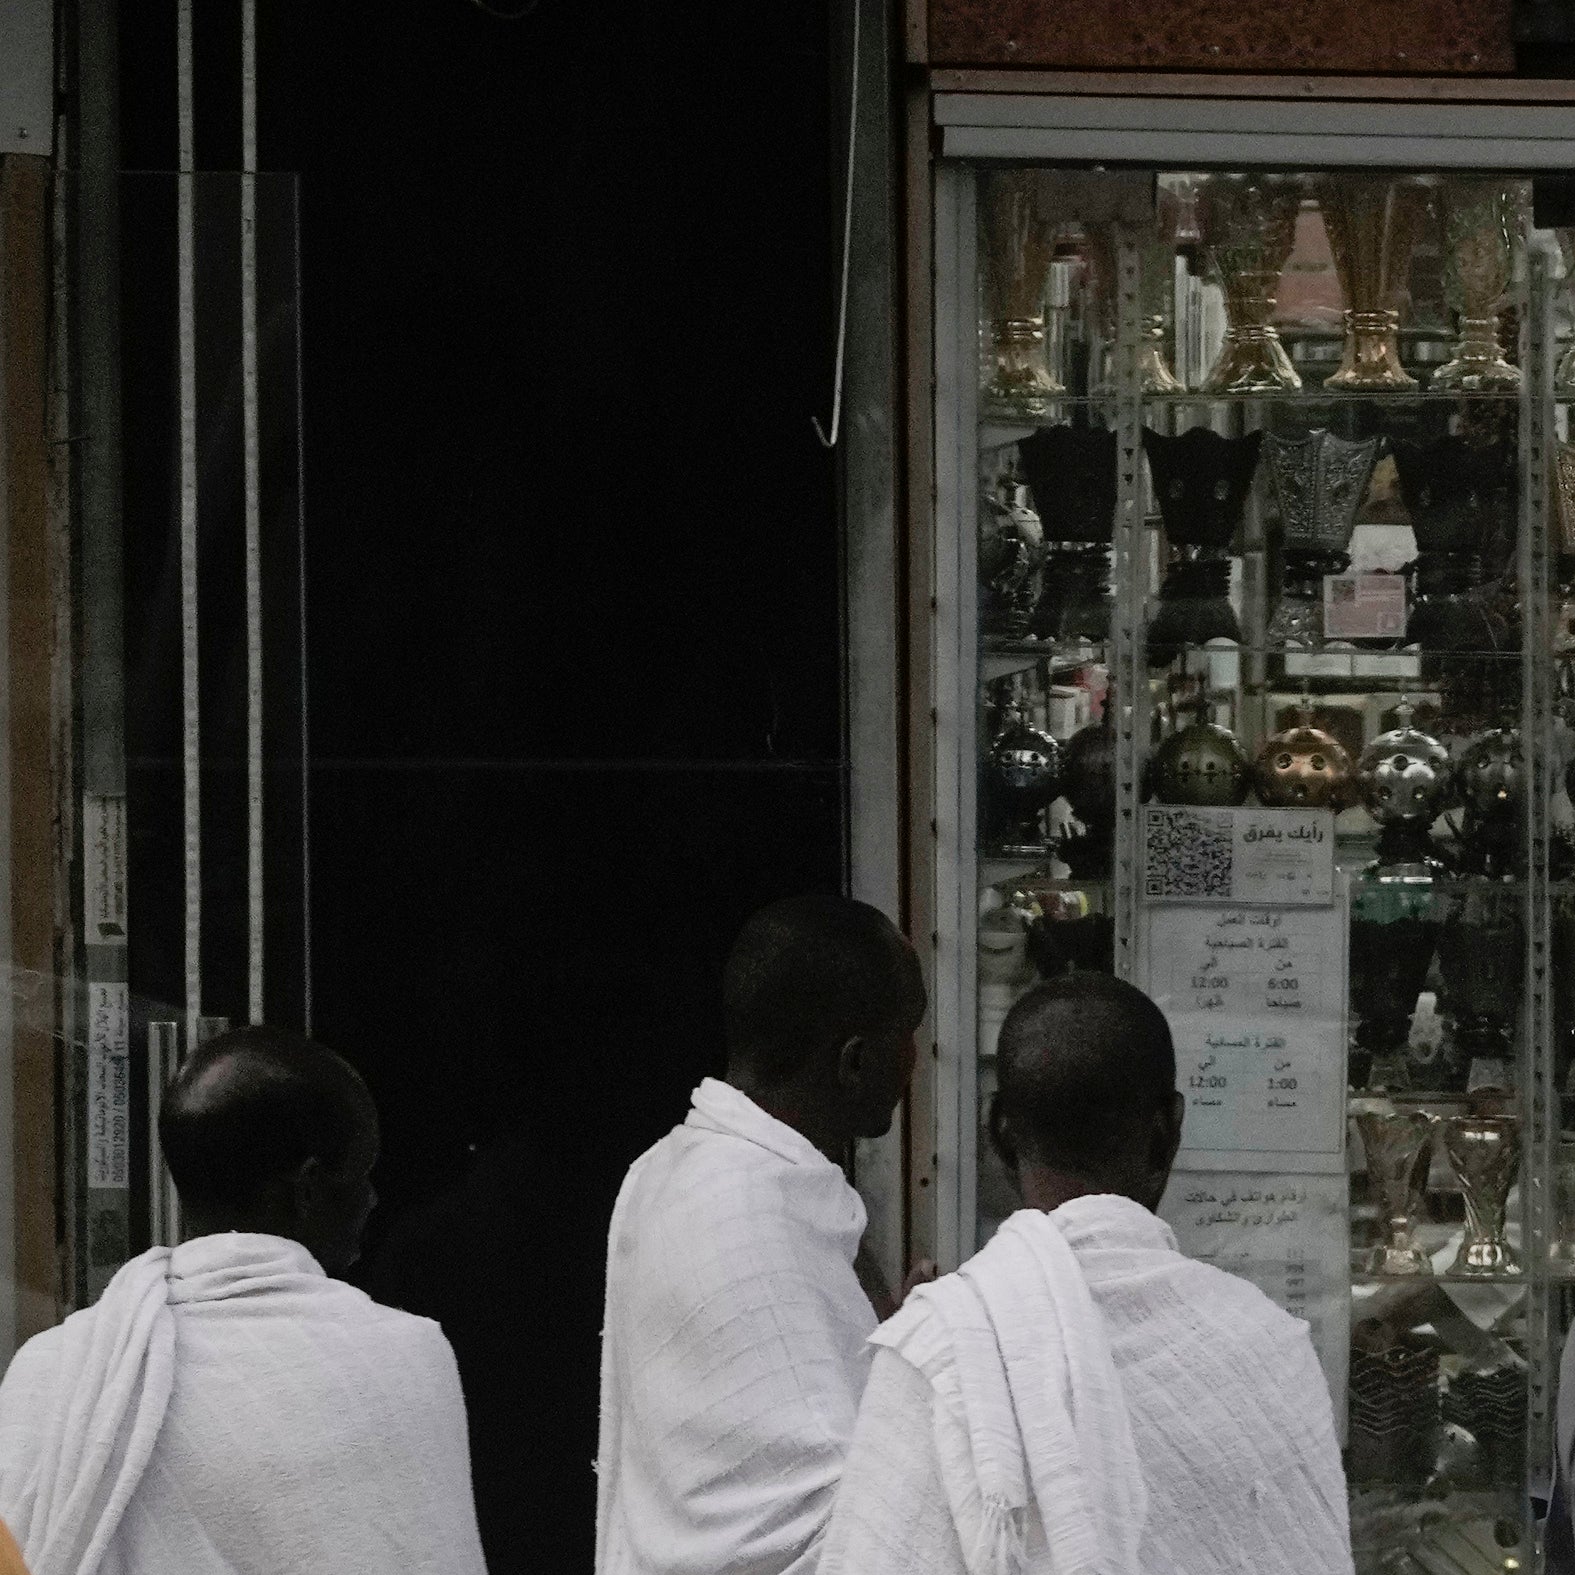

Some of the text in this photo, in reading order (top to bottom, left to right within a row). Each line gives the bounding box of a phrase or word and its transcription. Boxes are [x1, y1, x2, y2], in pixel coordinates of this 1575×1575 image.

[1190, 976, 1299, 990] 6:00 12:00
[1188, 1075, 1298, 1090] 1:00 12:00
